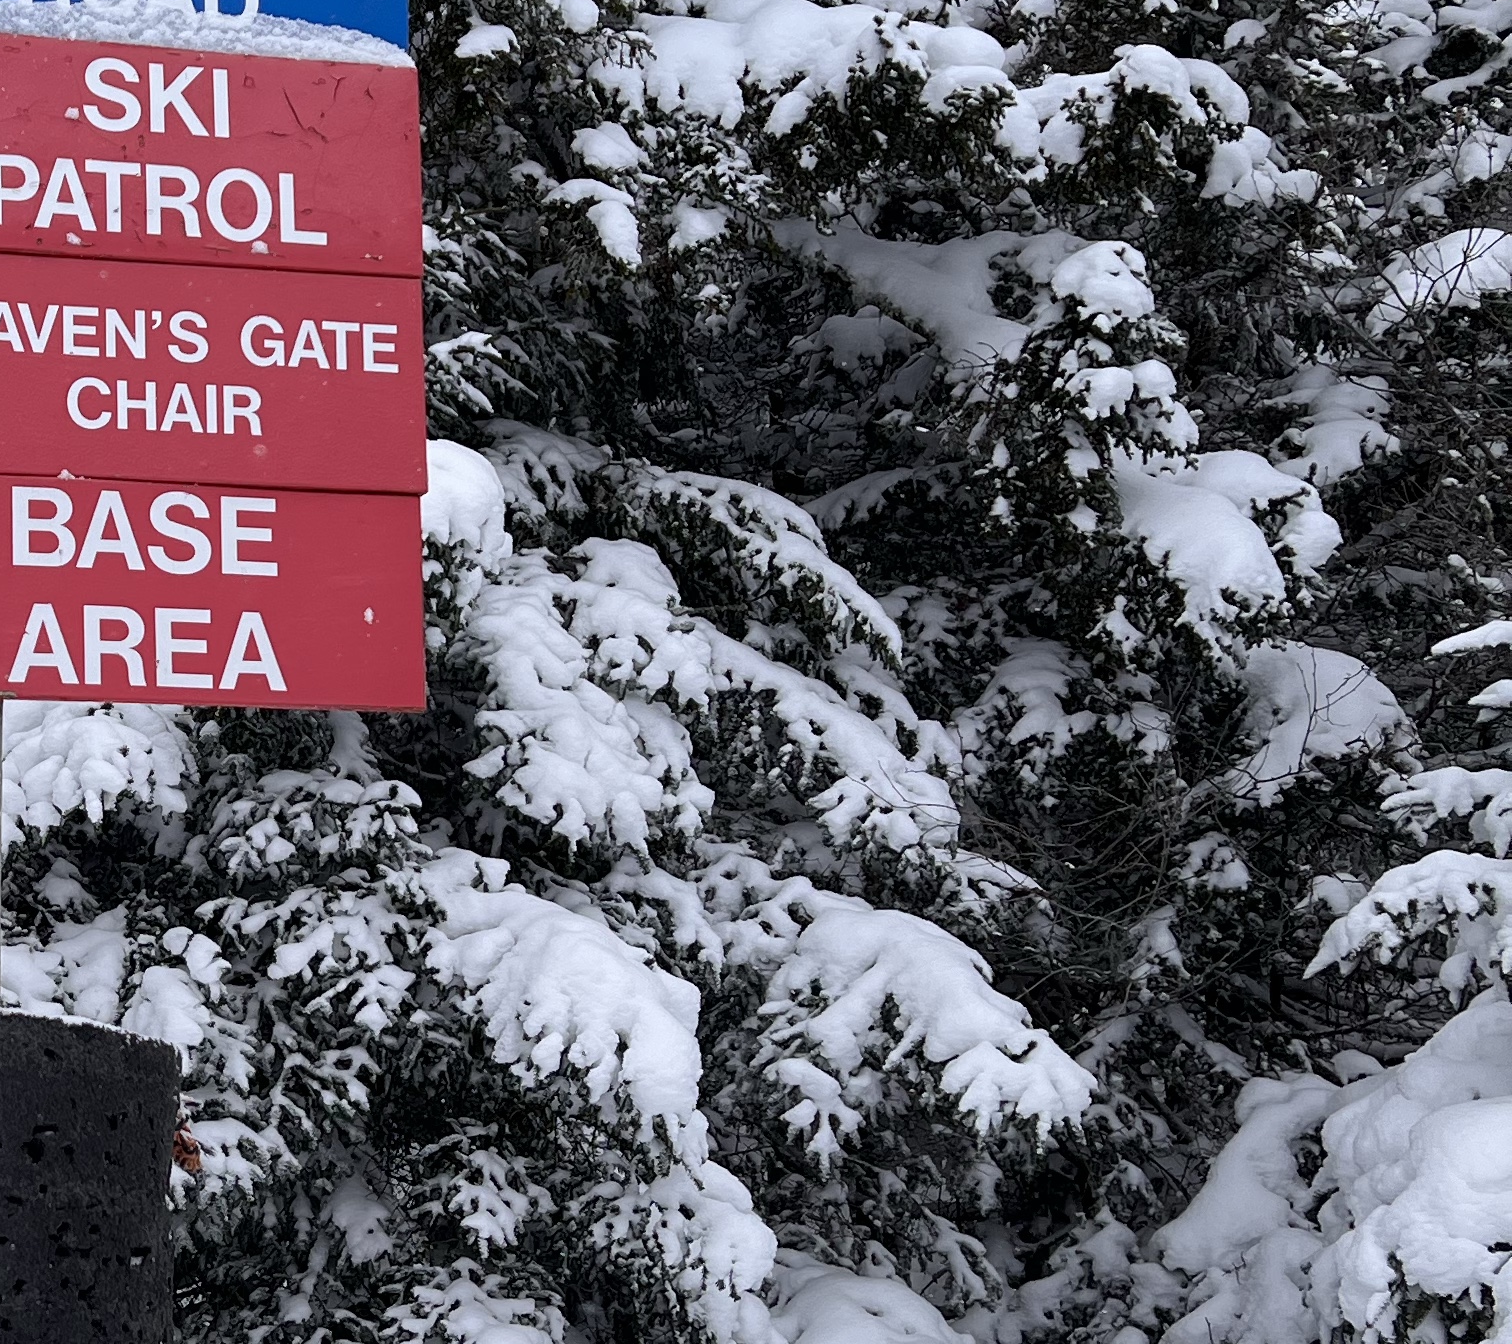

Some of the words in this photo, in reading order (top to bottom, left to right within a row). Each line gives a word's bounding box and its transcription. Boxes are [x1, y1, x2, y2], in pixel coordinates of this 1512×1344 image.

[82, 57, 230, 139] SKI
[240, 315, 399, 374] GATE
[66, 376, 263, 437] CHAIR
[11, 485, 279, 577] BASE
[7, 603, 288, 692] AREA
